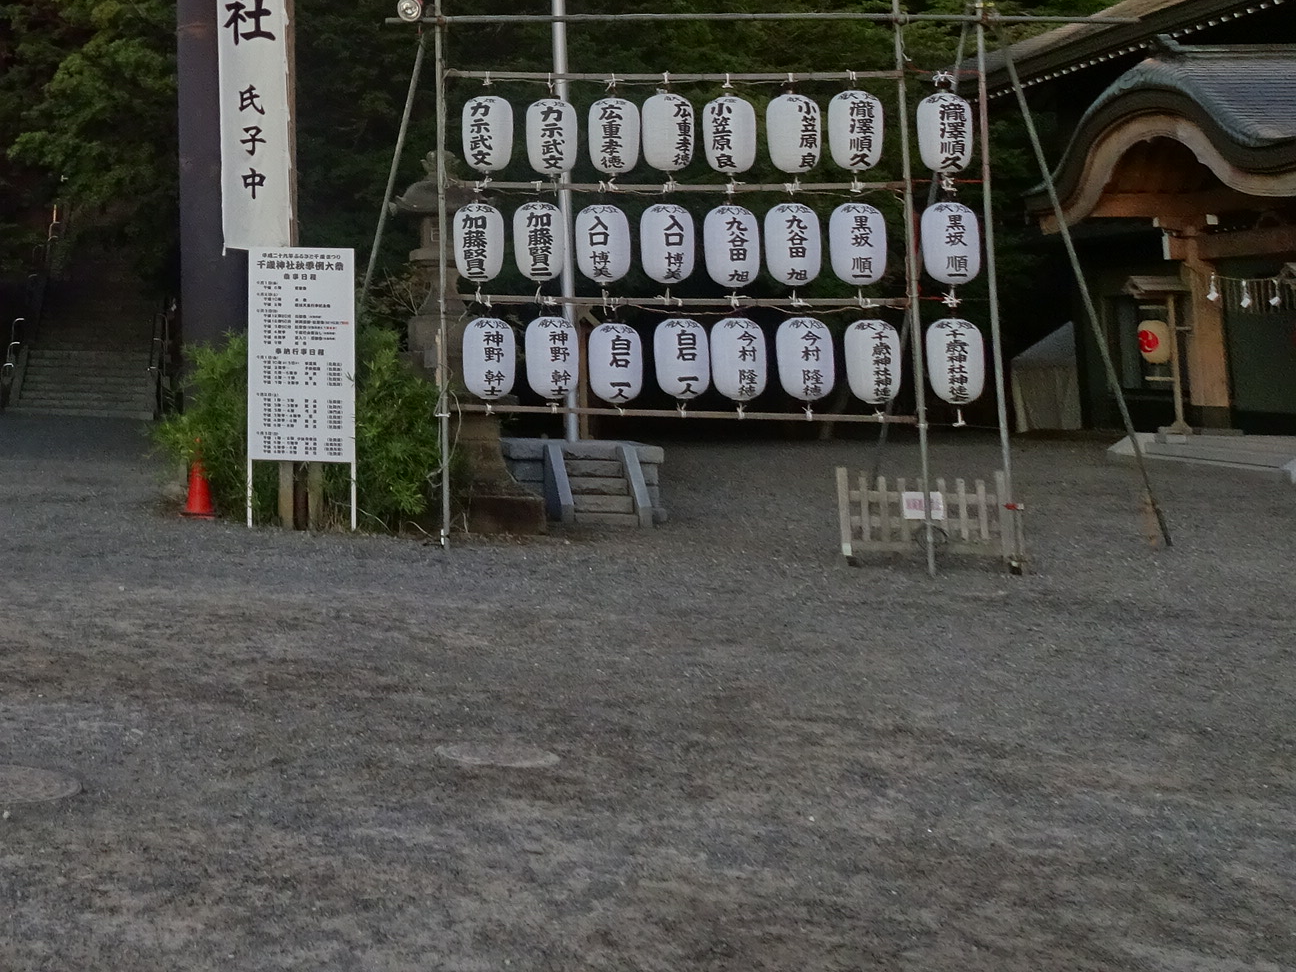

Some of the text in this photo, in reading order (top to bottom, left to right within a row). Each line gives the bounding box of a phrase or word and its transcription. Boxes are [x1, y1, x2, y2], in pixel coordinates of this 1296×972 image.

[237, 84, 266, 201] 氏子中
[599, 104, 625, 168] 広重孝徳
[672, 102, 692, 166] 広重孝徳
[711, 102, 737, 168] 小笠原良
[798, 100, 818, 168] 小笠原良
[462, 215, 488, 279] 加藤賢二
[527, 212, 554, 276] 加藤賢二
[588, 216, 613, 277] 入口博美
[663, 216, 685, 280] 入口博美
[725, 217, 750, 282] 九谷田旭
[785, 215, 808, 280] 九谷田旭
[851, 216, 874, 279] 黒坂順一
[945, 215, 968, 278] 黒坂順一
[609, 335, 632, 399] 白石一人
[676, 330, 700, 395] 白石一人
